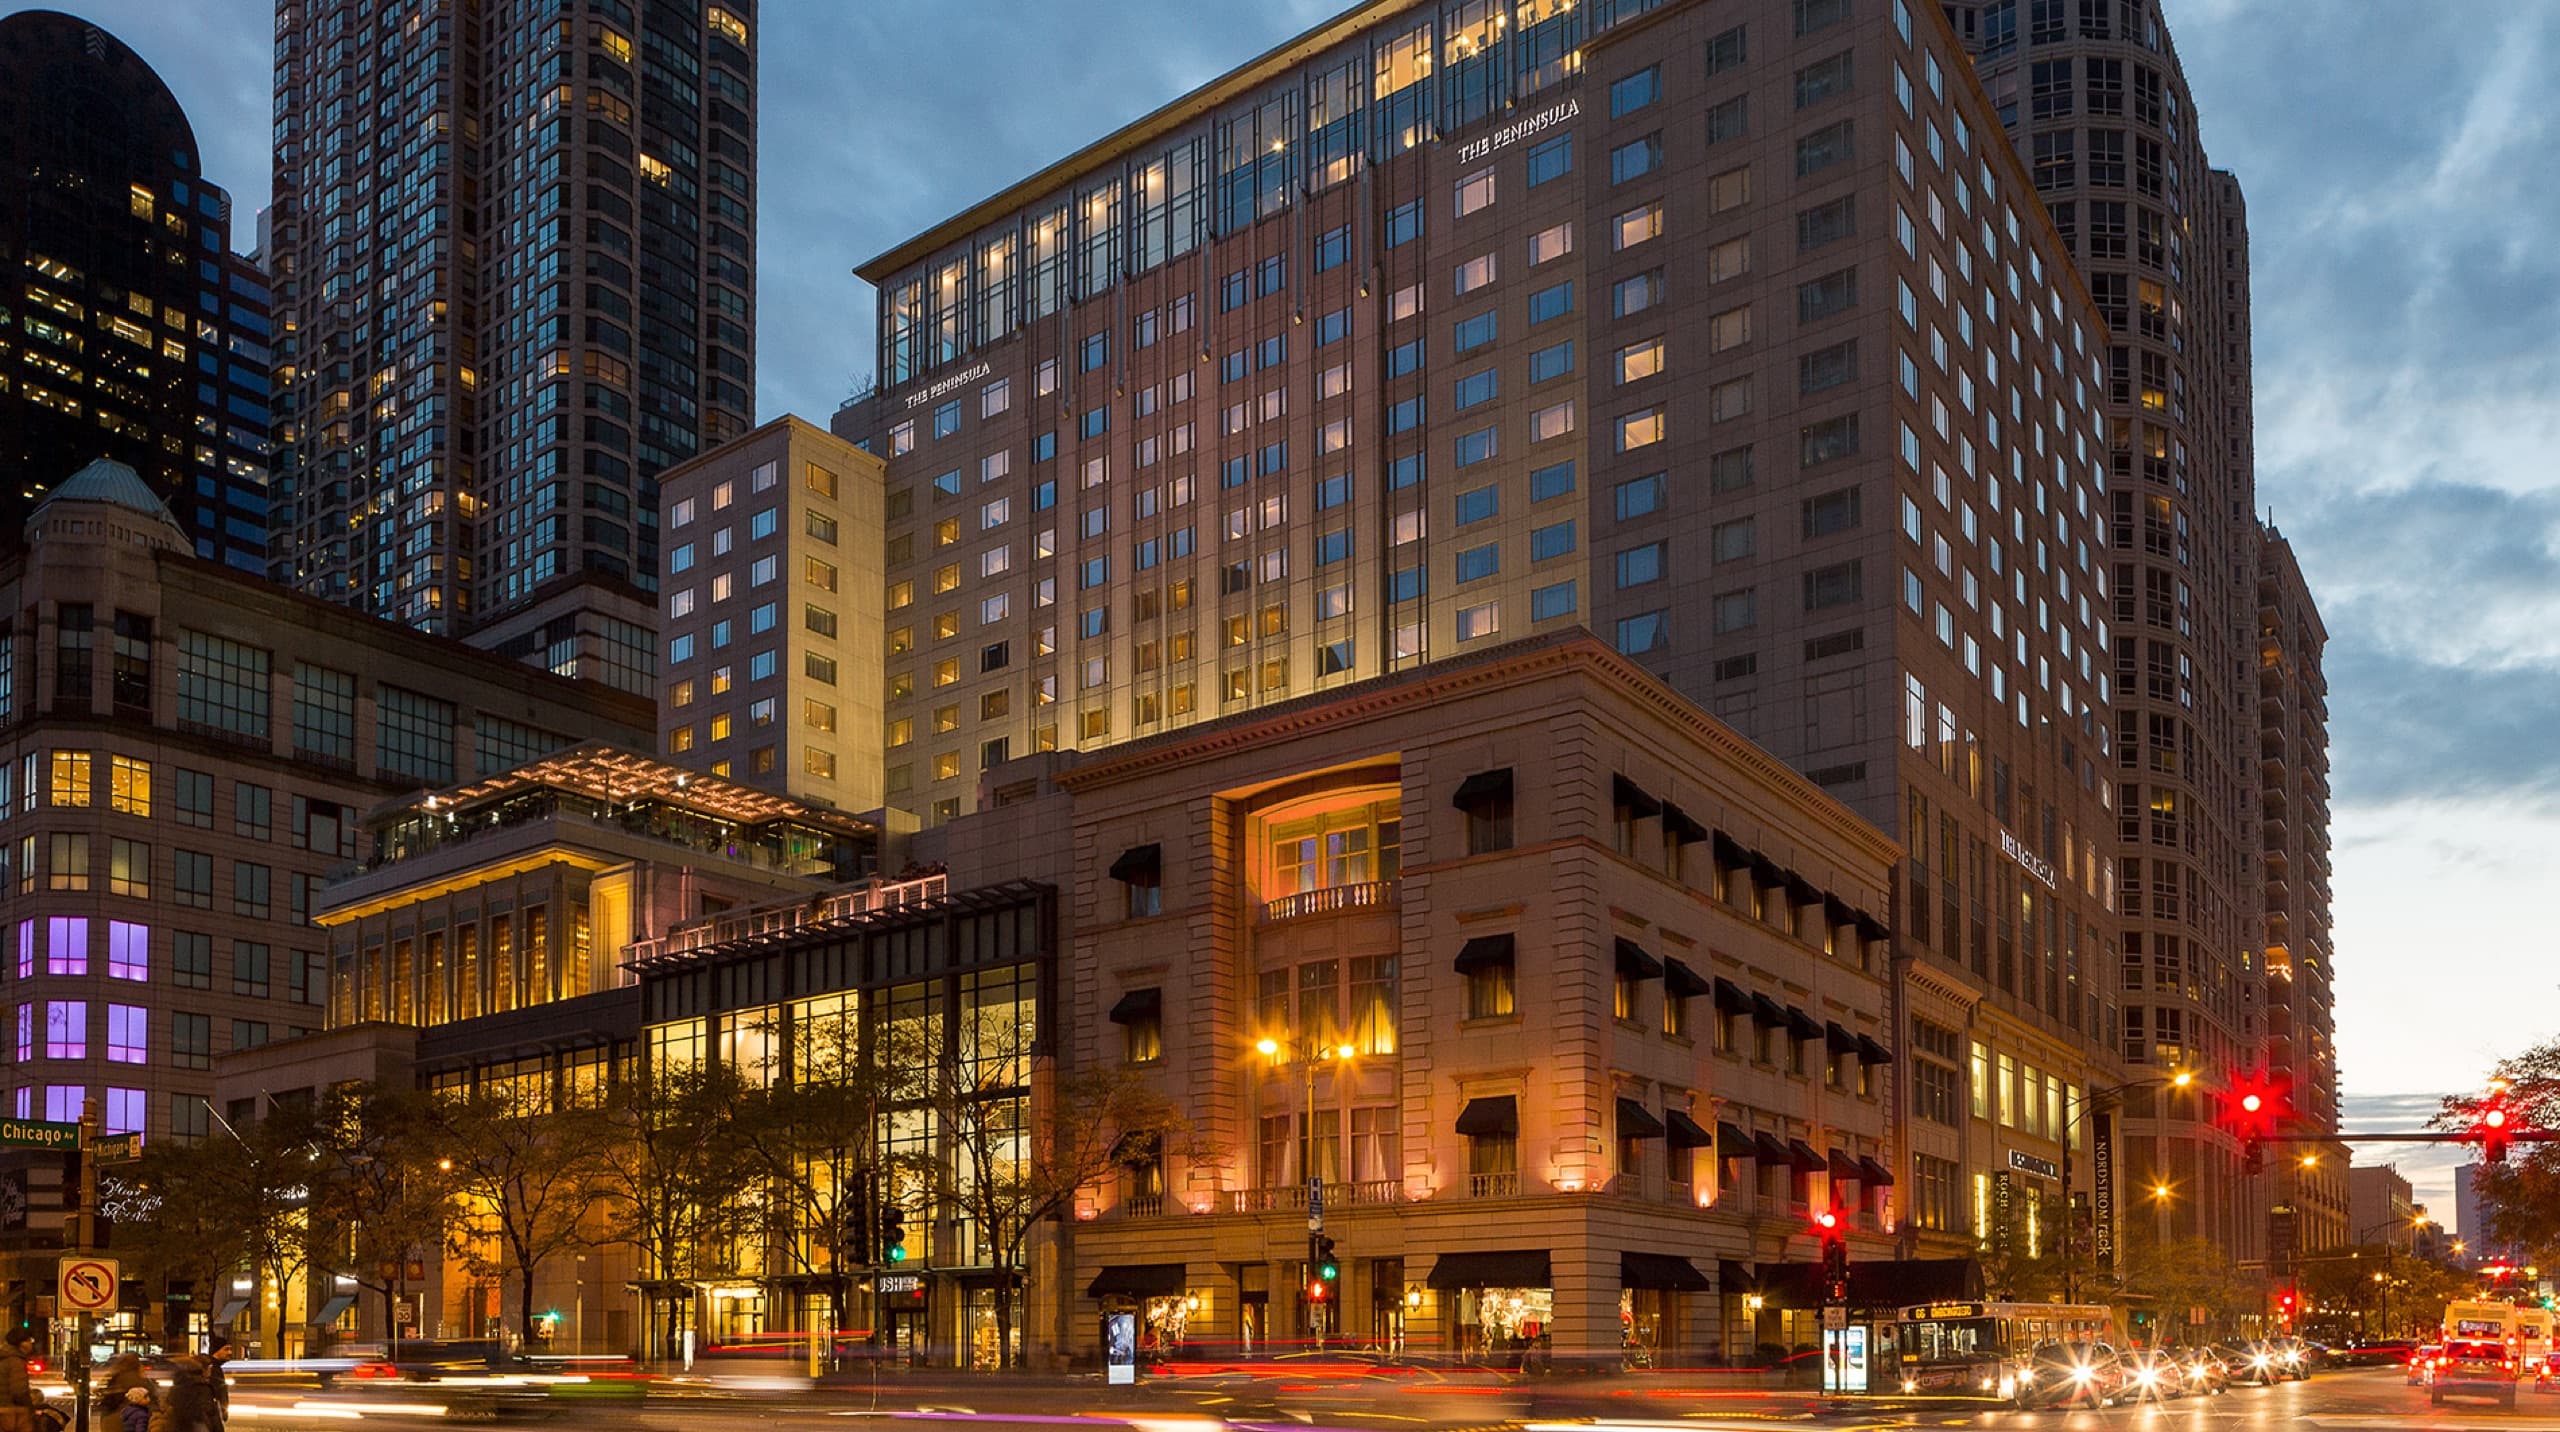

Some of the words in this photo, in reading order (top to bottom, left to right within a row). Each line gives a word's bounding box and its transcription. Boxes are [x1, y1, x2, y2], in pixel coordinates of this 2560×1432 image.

[1458, 137, 1490, 165] THE
[1493, 98, 1580, 151] PENINSULA
[904, 389, 928, 409] THE
[929, 361, 991, 399] PENINSULA
[3, 1123, 61, 1146] Chicago
[2096, 1141, 2109, 1220] NORDSTROM
[2098, 1224, 2112, 1257] rack
